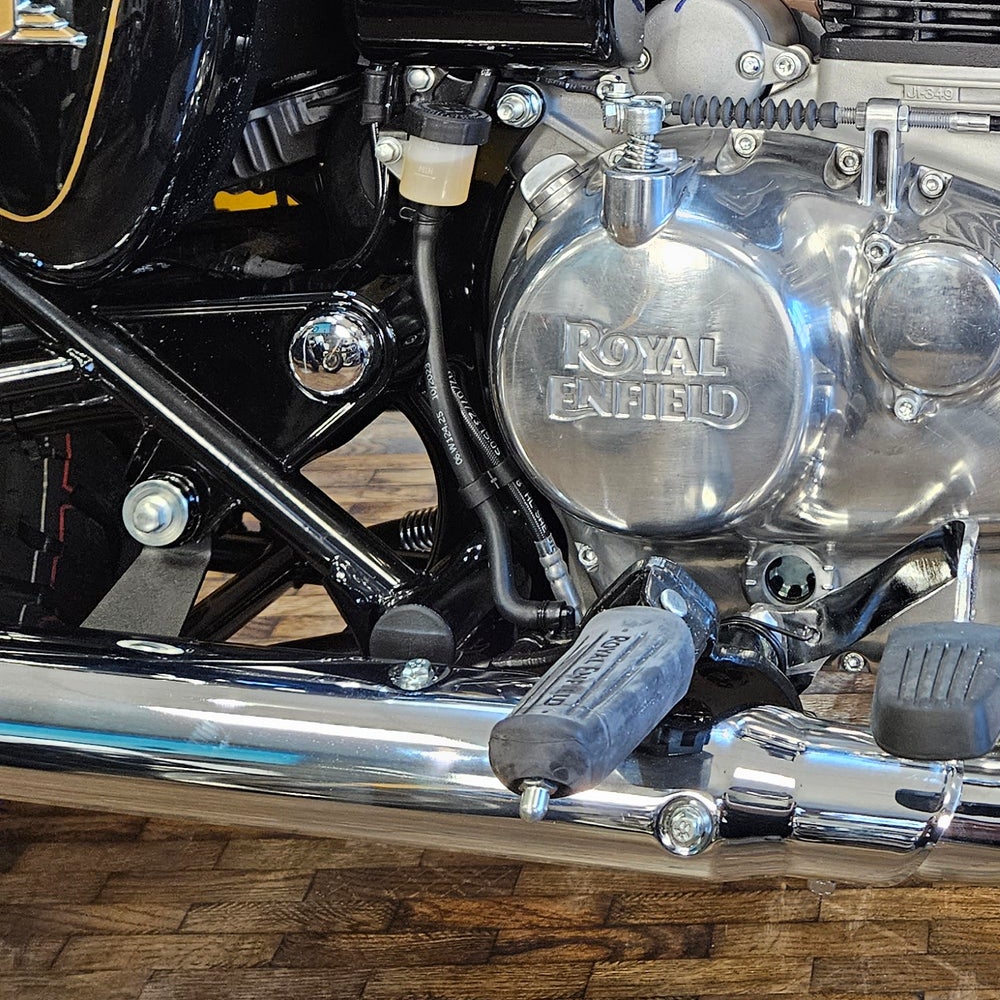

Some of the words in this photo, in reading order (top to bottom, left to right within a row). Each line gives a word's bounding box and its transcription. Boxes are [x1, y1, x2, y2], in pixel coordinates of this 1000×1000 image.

[907, 86, 954, 101] J1-349
[563, 316, 728, 377] ROYAL
[546, 375, 750, 430] ENFIELD
[584, 635, 631, 664] ROYAL
